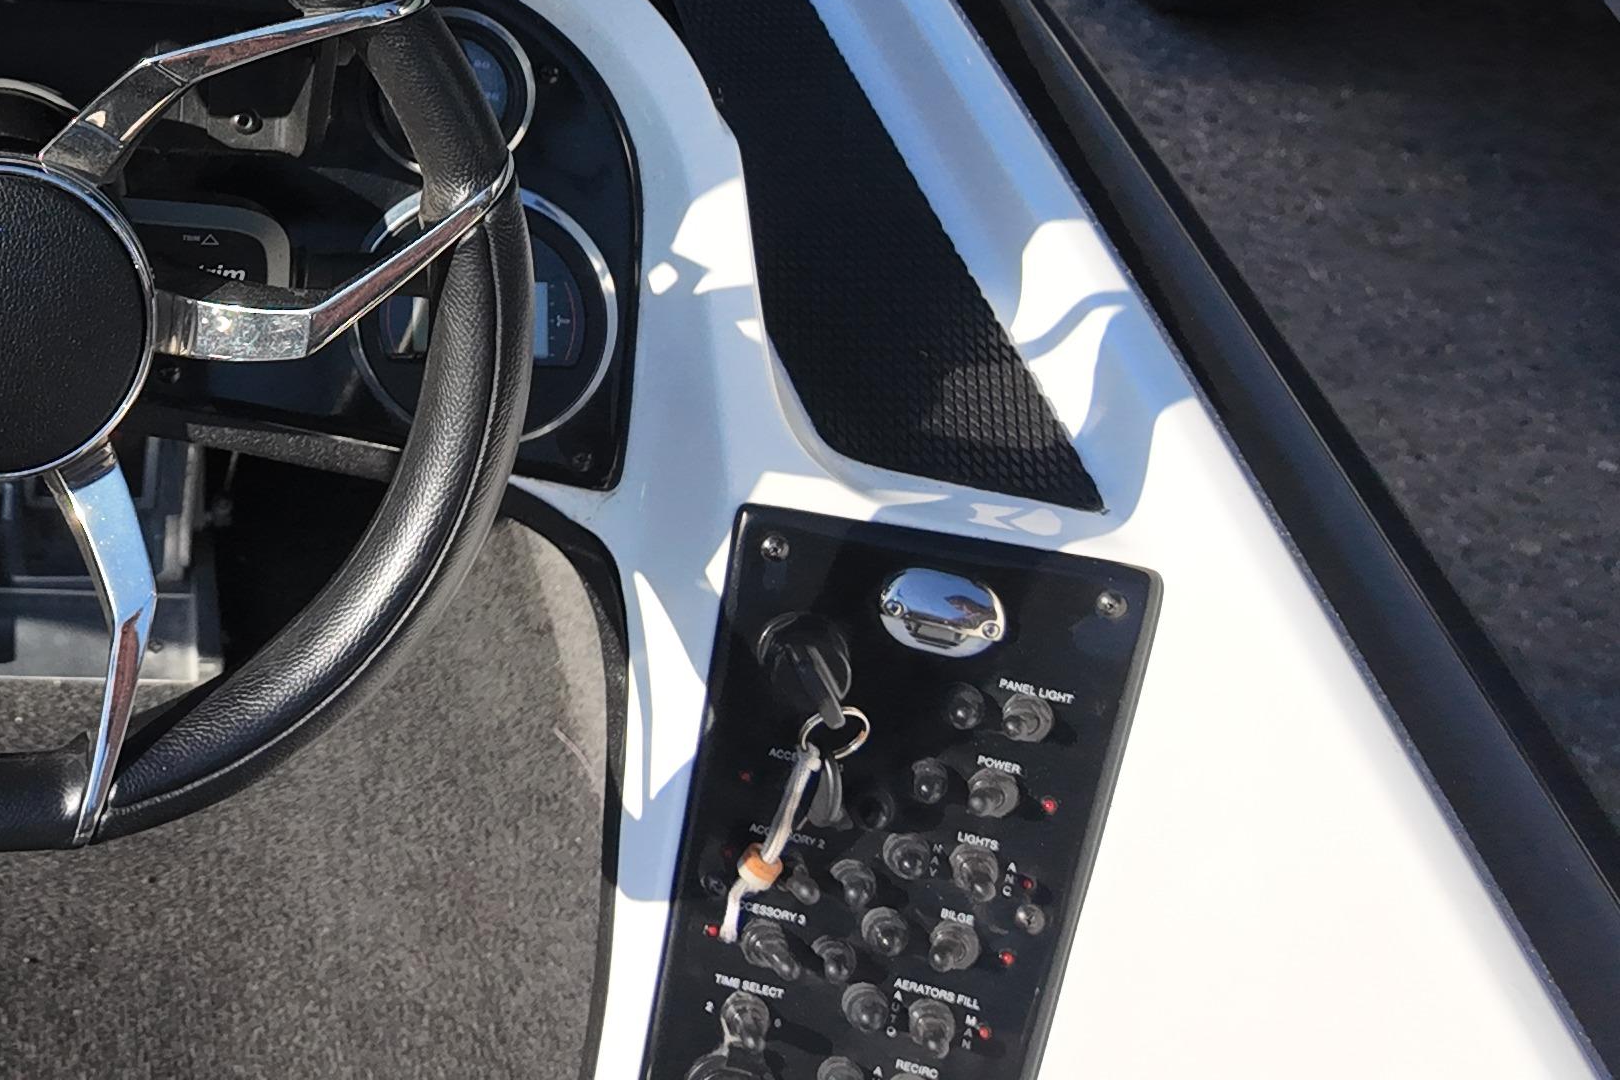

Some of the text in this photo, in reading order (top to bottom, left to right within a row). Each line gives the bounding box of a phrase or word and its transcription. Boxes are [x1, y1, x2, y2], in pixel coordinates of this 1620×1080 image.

[998, 677, 1076, 704] PANEL LIGHT
[977, 754, 1022, 775] POWER
[957, 831, 999, 851] LIGHTS
[797, 913, 807, 927] 3
[940, 907, 974, 926] BILGE
[715, 972, 785, 999] TIME SELECT
[893, 977, 980, 1011] AERATORS FILL
[895, 1058, 939, 1080] RECIRC
